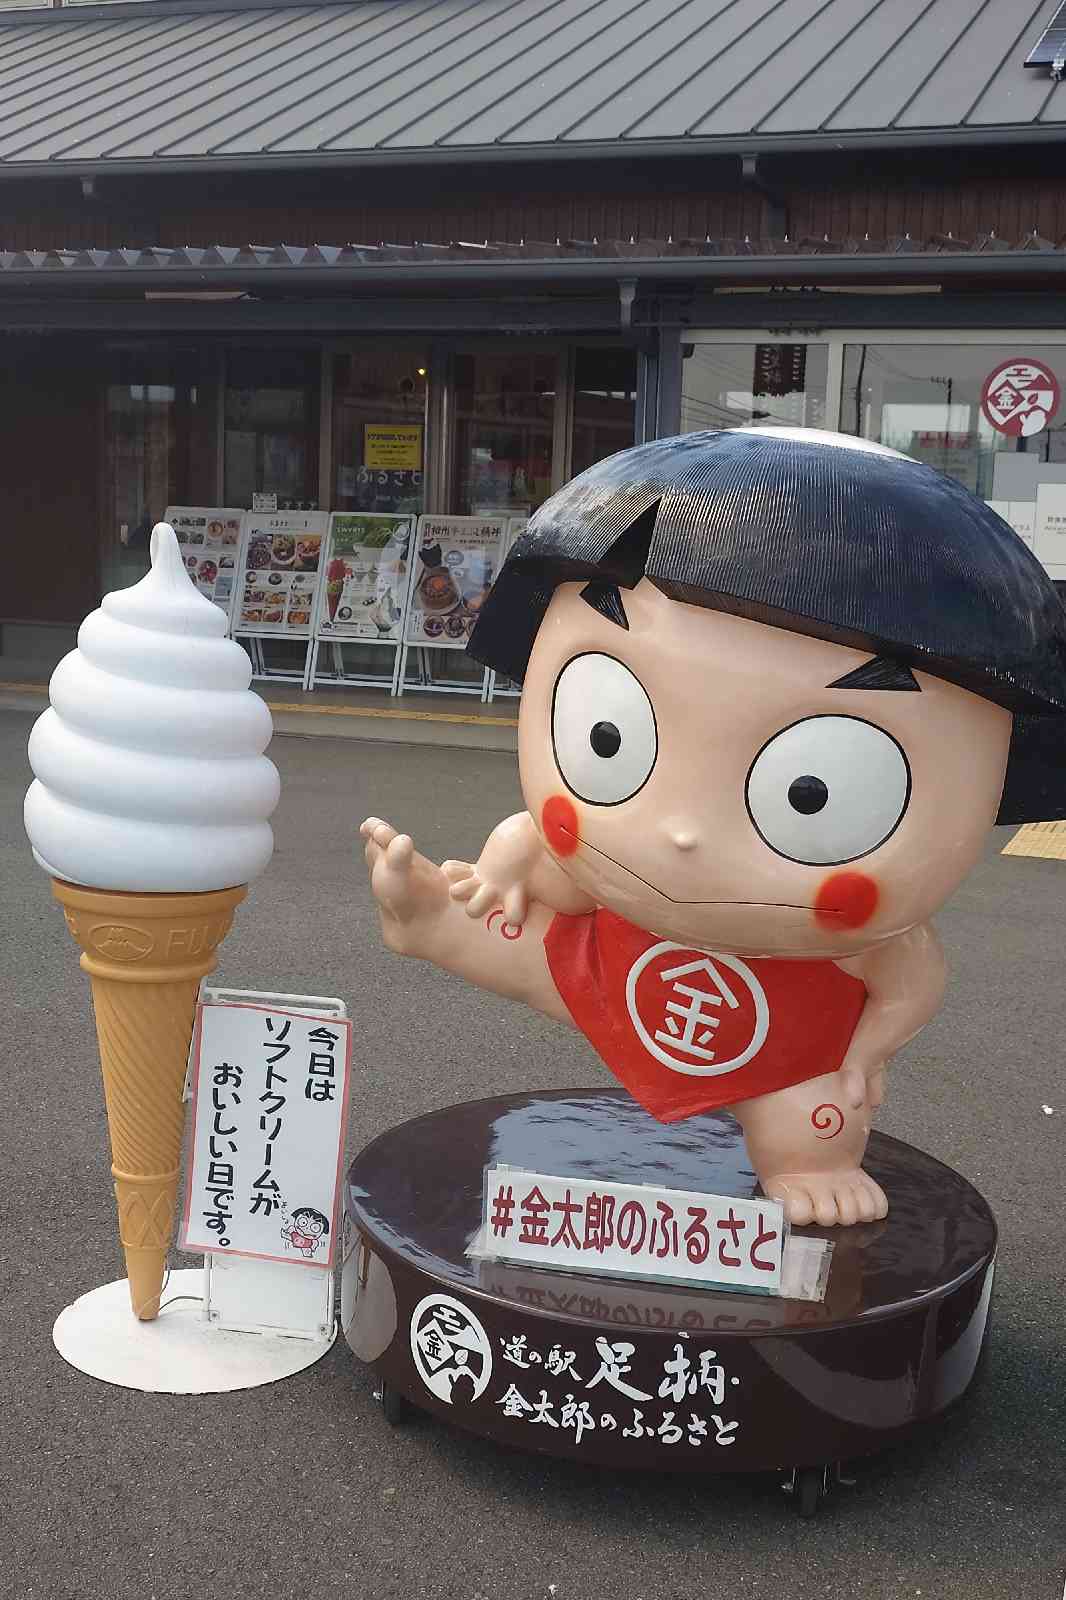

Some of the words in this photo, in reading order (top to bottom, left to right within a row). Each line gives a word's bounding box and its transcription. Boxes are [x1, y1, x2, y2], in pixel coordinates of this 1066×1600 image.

[654, 957, 740, 1061] 金
[304, 1027, 340, 1102] 今日は
[202, 1062, 244, 1247] おいしい日です。
[249, 1017, 292, 1217] ソフトクリームが
[491, 1185, 777, 1272] #金太郎のふるさと
[496, 1383, 740, 1444] 金太郎のふるさと
